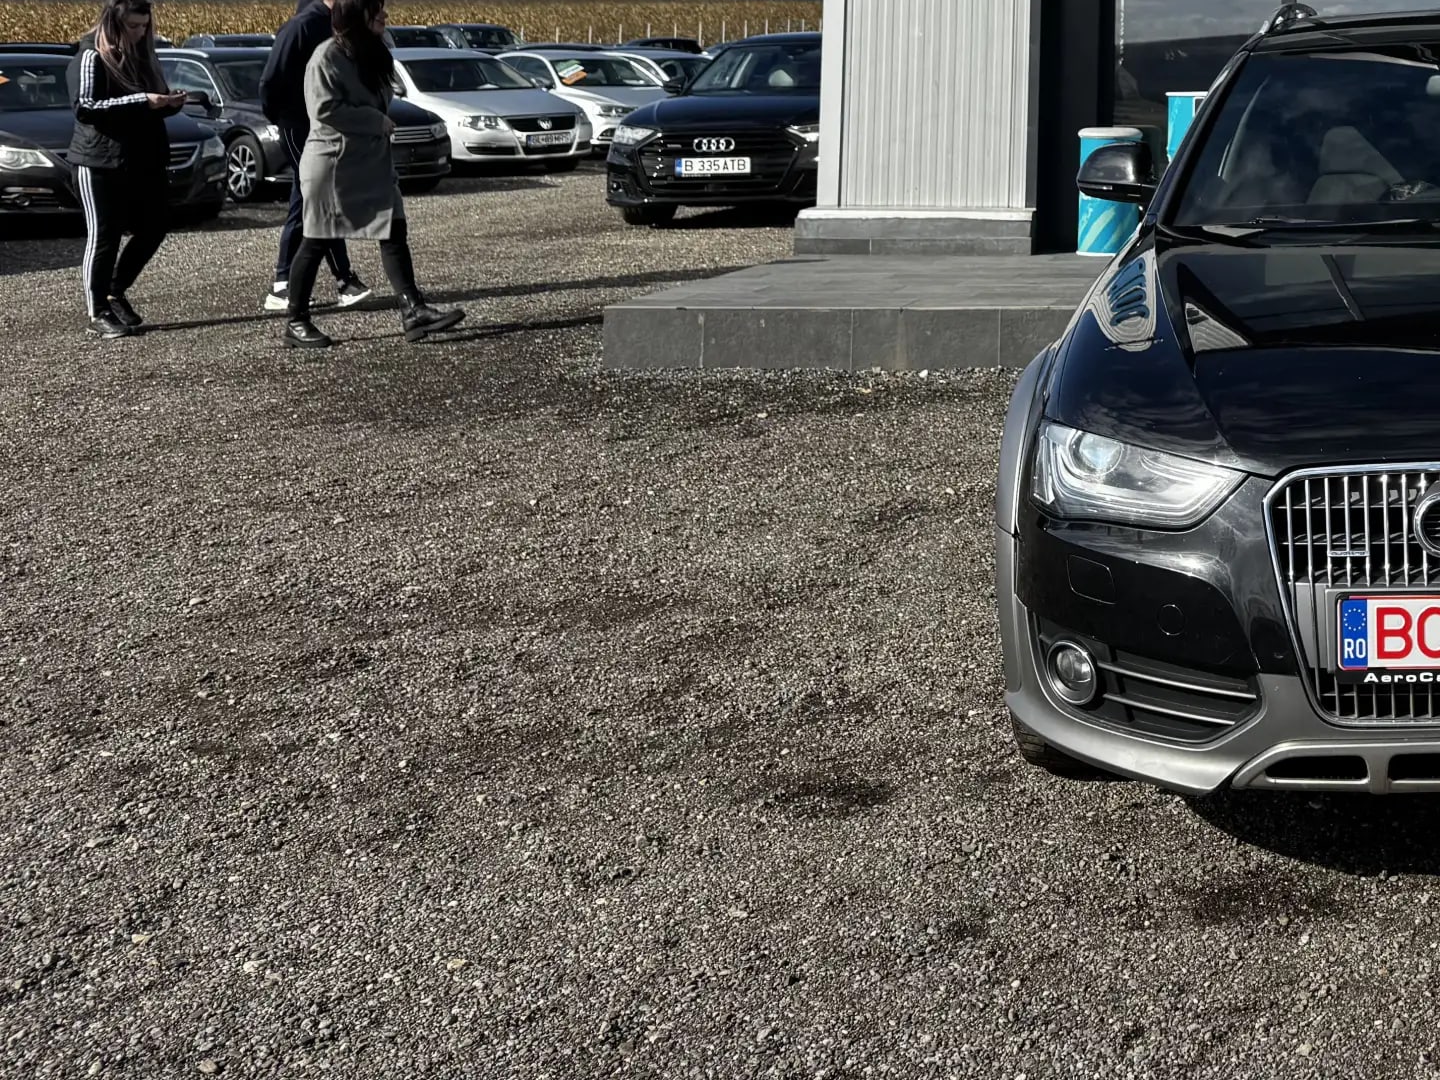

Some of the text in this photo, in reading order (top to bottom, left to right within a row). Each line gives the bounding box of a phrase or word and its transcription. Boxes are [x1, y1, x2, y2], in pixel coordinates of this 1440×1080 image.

[684, 158, 746, 172] B 335 ATB
[1343, 638, 1367, 660] RO
